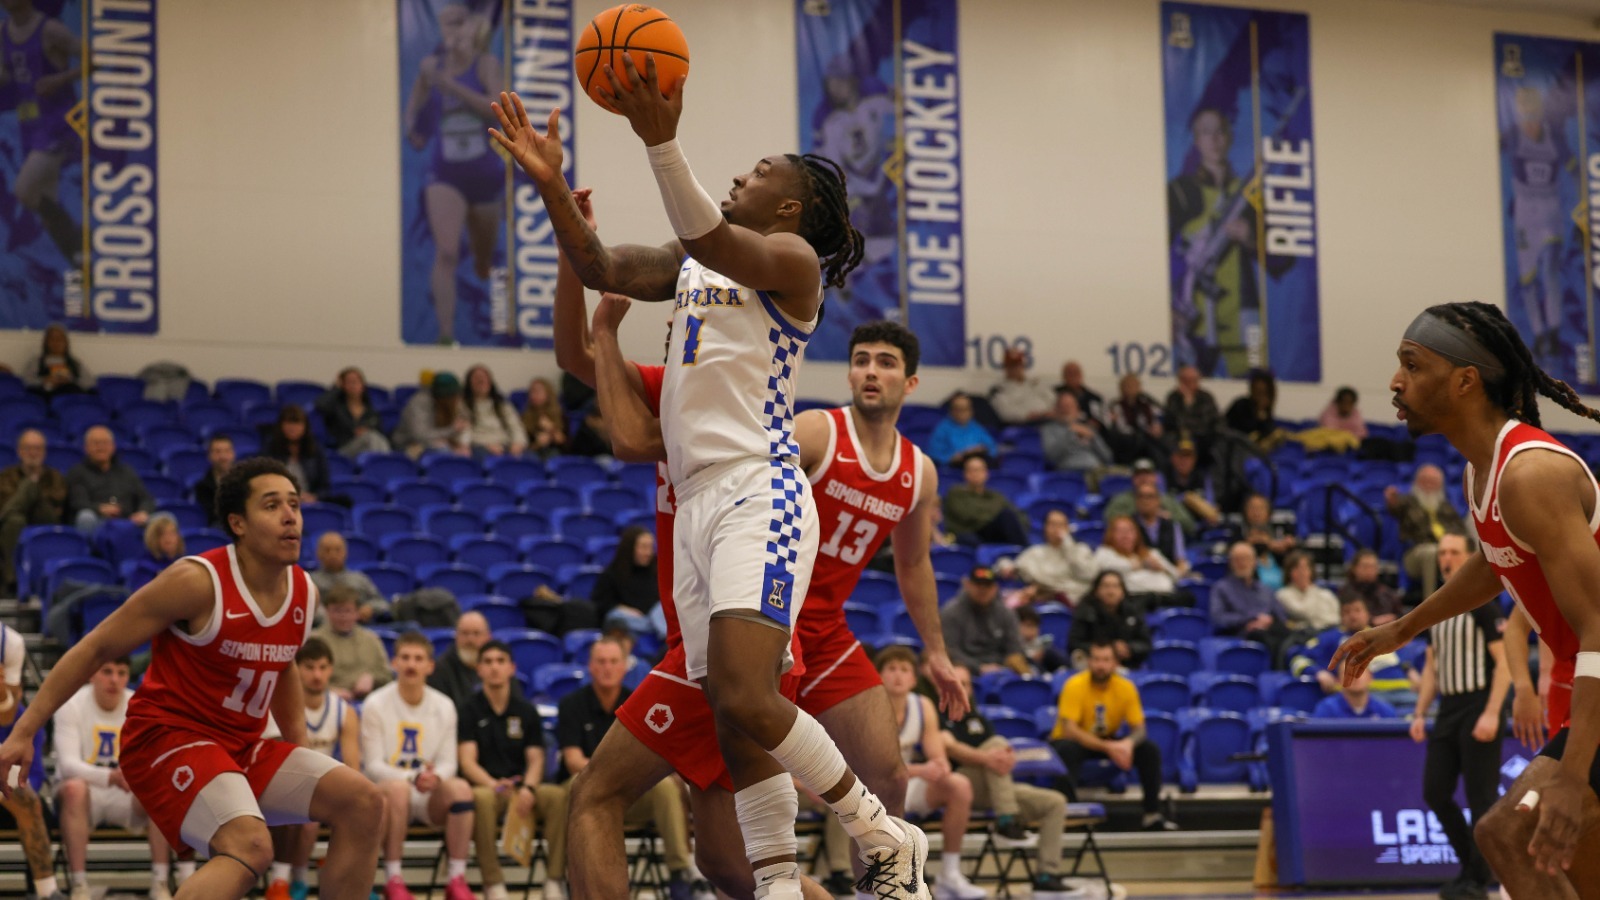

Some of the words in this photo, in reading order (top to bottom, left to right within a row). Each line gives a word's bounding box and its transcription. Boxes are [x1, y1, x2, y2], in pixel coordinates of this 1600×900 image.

[902, 39, 960, 223] HOCKEY
[1263, 136, 1314, 257] RIFLE
[92, 162, 154, 323] CROSS
[908, 231, 962, 306] ICE
[1107, 342, 1171, 377] 102
[825, 479, 866, 509] SIMON
[863, 495, 905, 522] FRASER
[819, 510, 879, 566] 13
[218, 639, 261, 662] SIMON
[222, 667, 279, 719] 10
[1371, 808, 1472, 845] LAS
